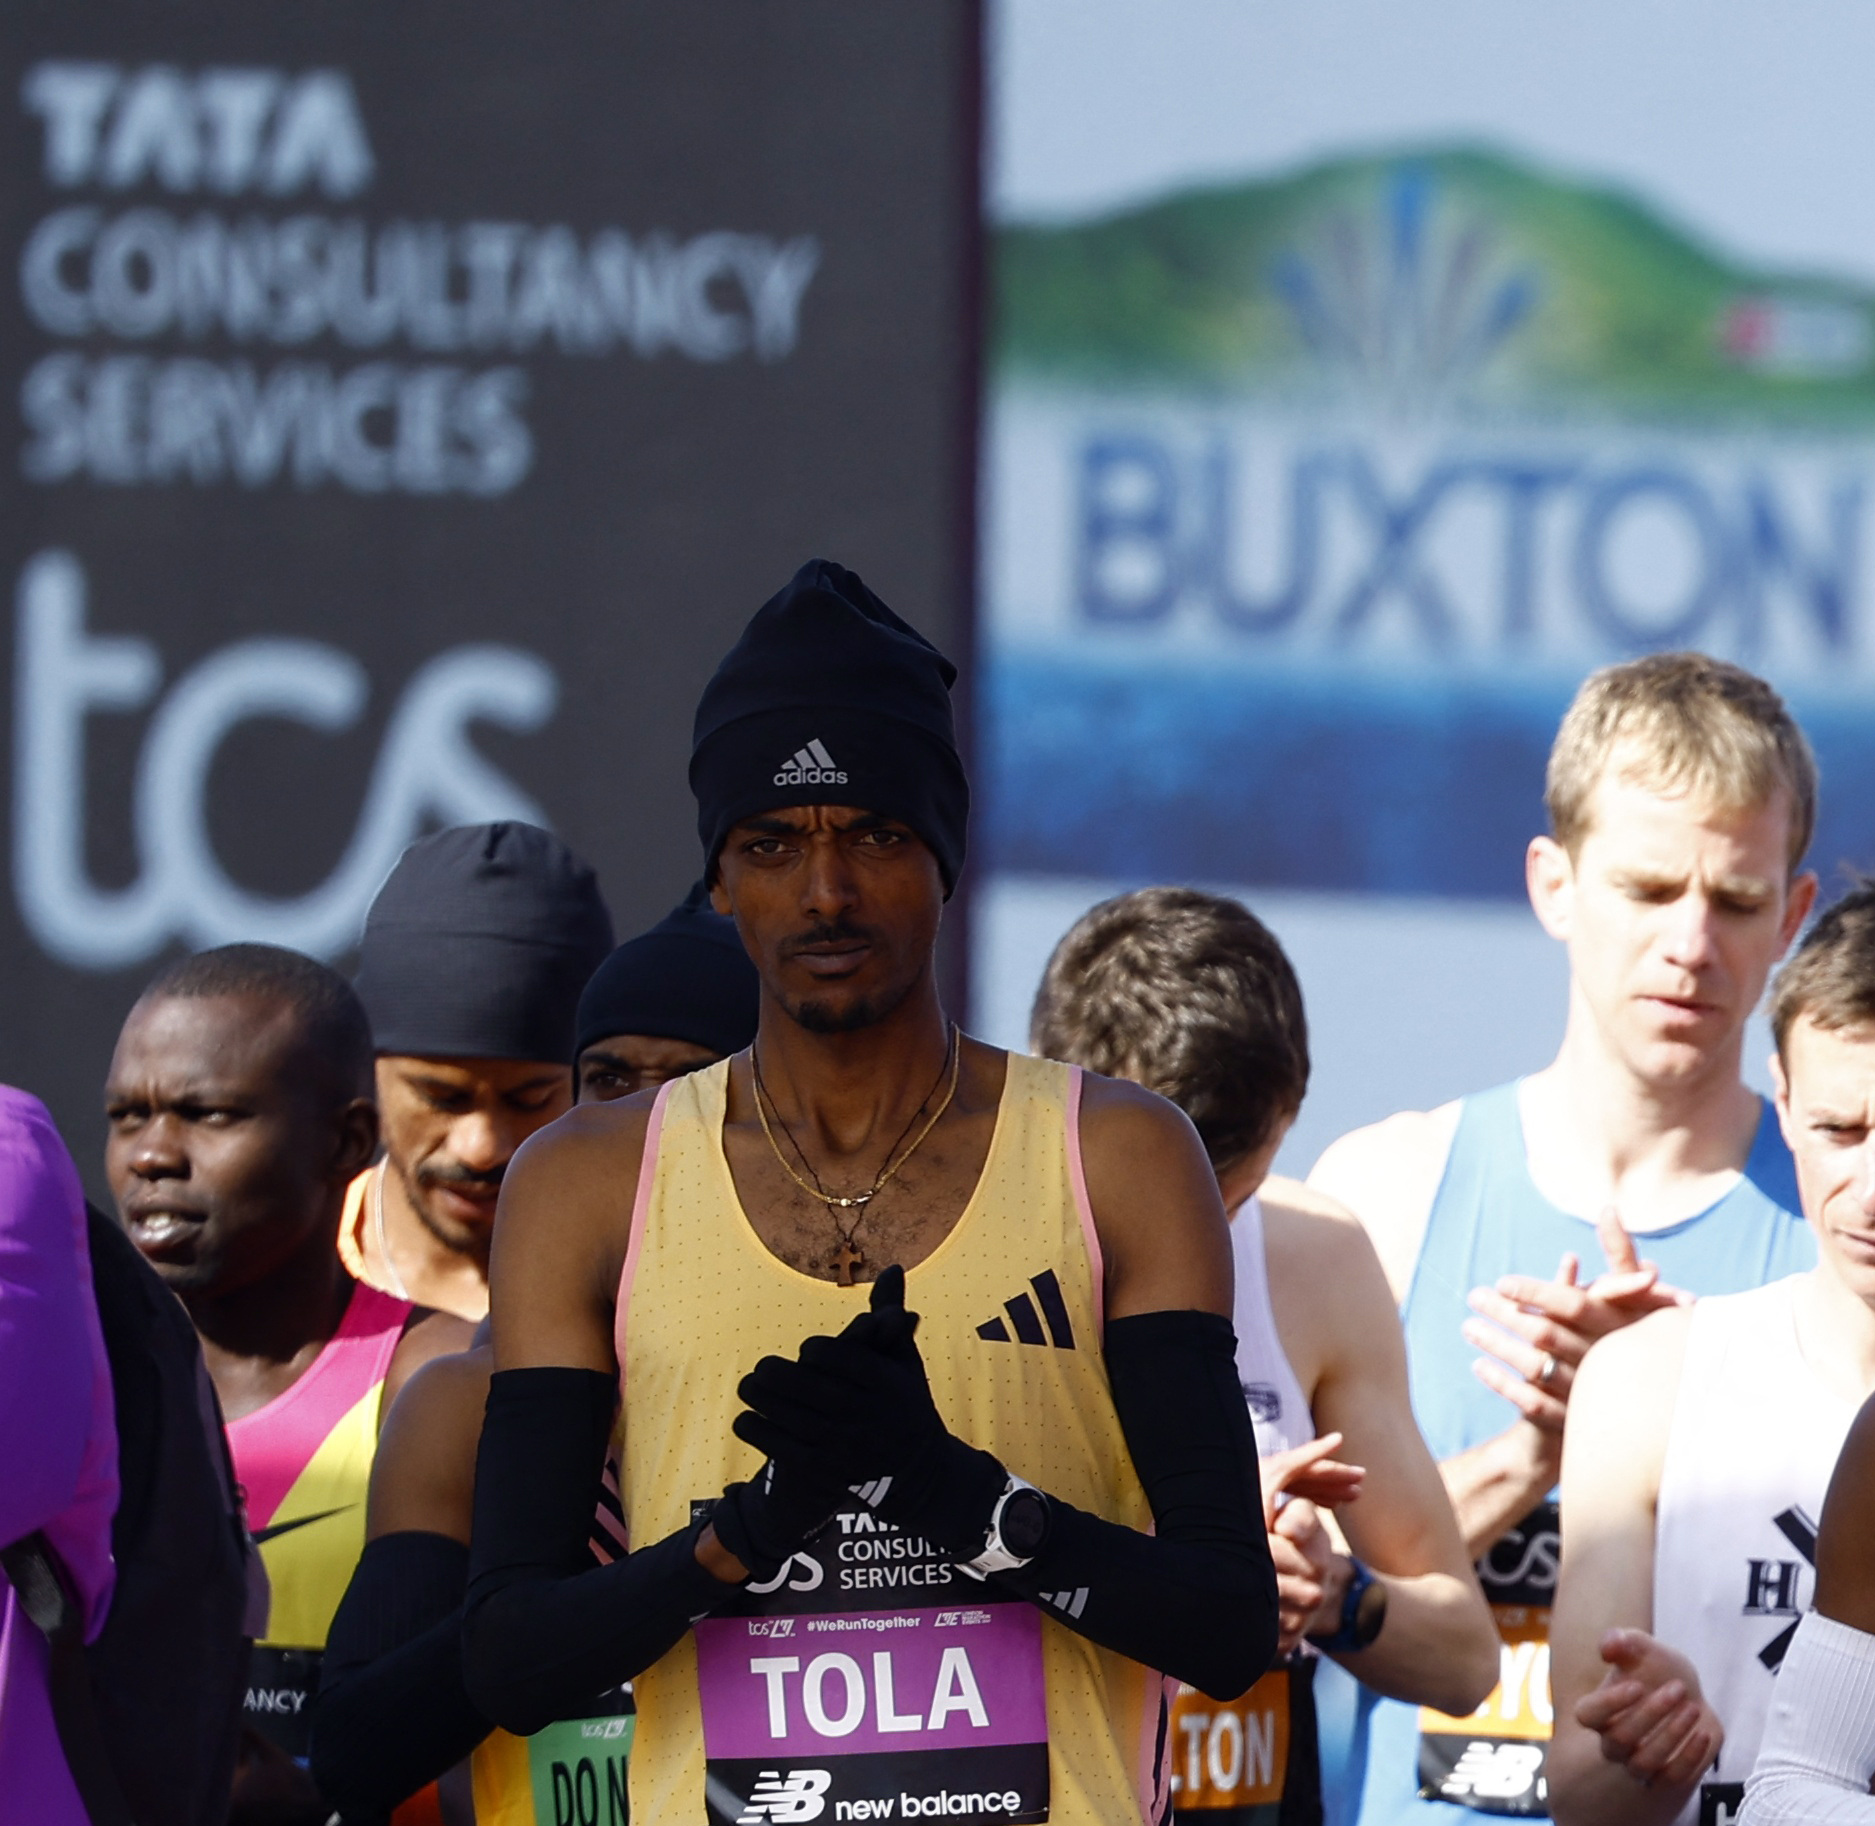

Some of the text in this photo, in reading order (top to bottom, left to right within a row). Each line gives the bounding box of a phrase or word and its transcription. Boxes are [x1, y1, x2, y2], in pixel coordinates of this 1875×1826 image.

[26, 60, 376, 194] TATA
[20, 205, 820, 363] CONSULTANCY
[20, 352, 536, 496] SERVICES
[1071, 437, 1866, 660] BUXTON
[773, 767, 849, 787] adidas
[836, 1513, 901, 1534] TA
[839, 1563, 953, 1590] SERVICES
[806, 1615, 921, 1633] #WeRunTogether
[750, 1646, 990, 1739] TOLA
[1171, 1710, 1276, 1792] TON
[736, 1769, 833, 1824] NB
[836, 1790, 1021, 1822] new balance
